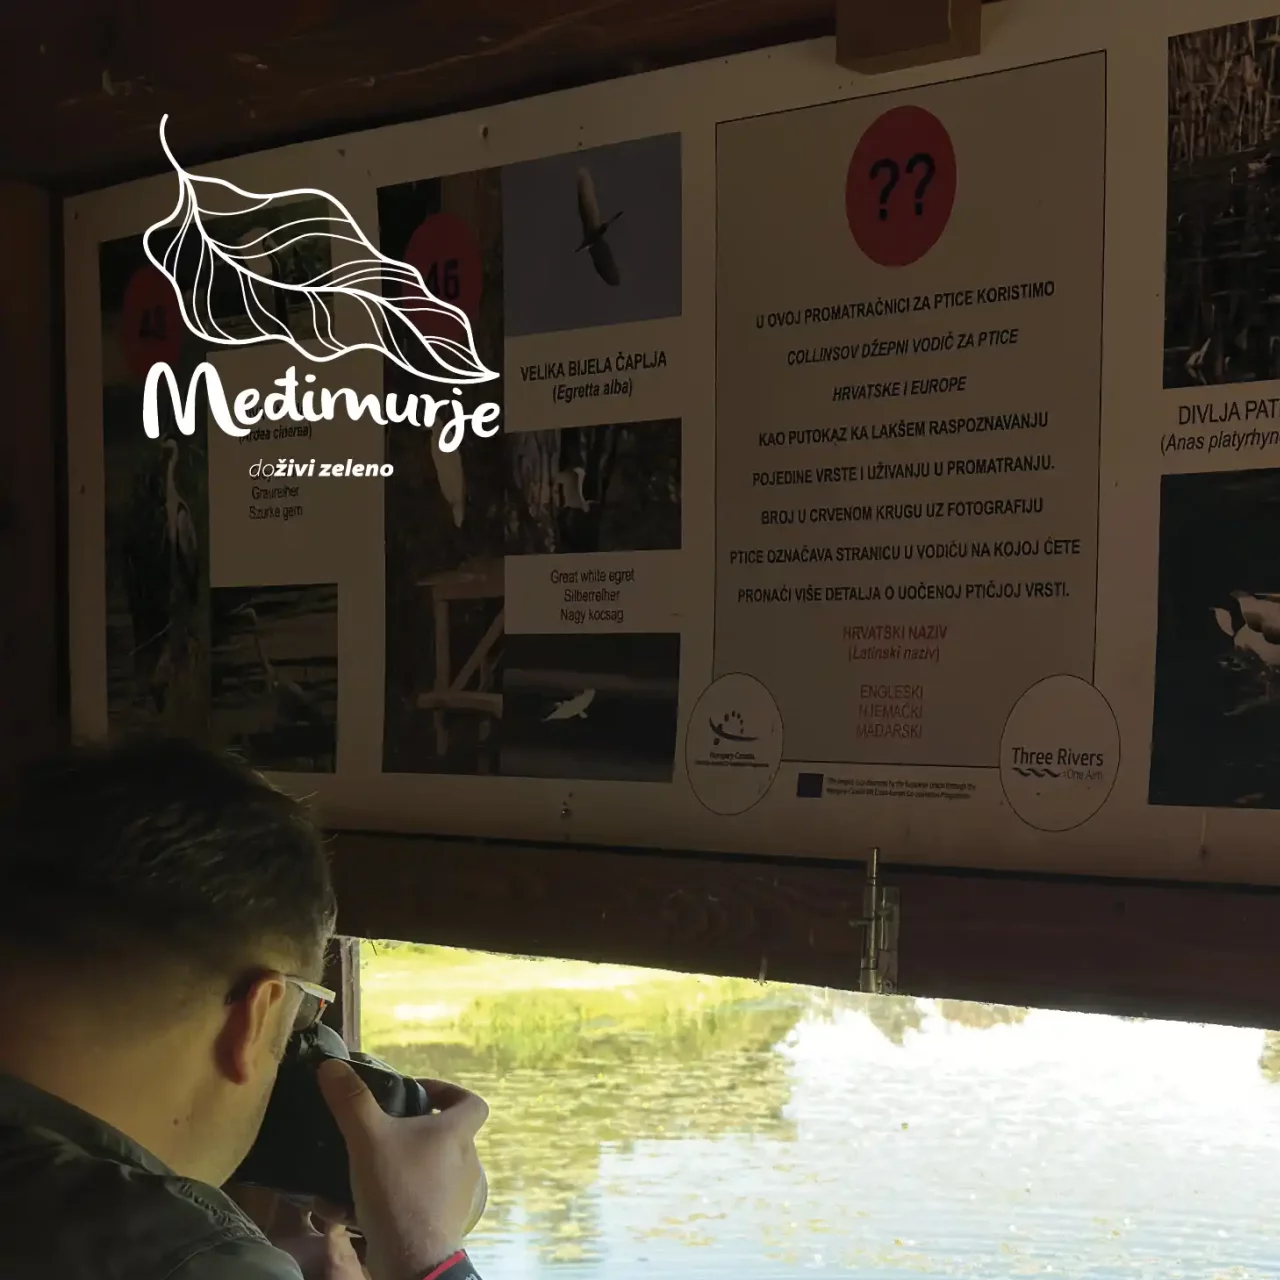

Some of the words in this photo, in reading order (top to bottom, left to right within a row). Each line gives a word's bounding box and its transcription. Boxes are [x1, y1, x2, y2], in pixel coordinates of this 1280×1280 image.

[869, 152, 936, 221] ??
[427, 258, 460, 300] 46
[756, 315, 764, 329] U
[767, 310, 801, 328] OVOJ
[804, 298, 910, 324] PROMATRAČNICI
[913, 296, 931, 311] ZA
[934, 289, 973, 309] PTICE
[976, 280, 1055, 304] KORISTIMO
[787, 344, 859, 366] COLLINSOV
[861, 337, 909, 359] DŽEPNI
[956, 333, 975, 350] ZA
[977, 328, 1019, 348] PTICE
[520, 364, 565, 382] VELIKA
[568, 359, 612, 377] BIJELA
[615, 351, 667, 371] ČAPLJA
[552, 381, 600, 403] (Egretta
[603, 378, 633, 397] alba)
[832, 382, 900, 402] HRVATSKE
[902, 381, 908, 396] I
[910, 375, 968, 395] EUROPE
[1178, 403, 1240, 425] DIVLJA
[759, 430, 785, 447] KAO
[788, 426, 847, 445] PUTOKAZ
[850, 425, 869, 441] KA
[871, 418, 926, 440] LAKŠEM
[929, 411, 1049, 436] RASPOZNAVANJU
[1160, 429, 1205, 454] (Anas
[752, 469, 812, 487] POJEDINE
[815, 466, 857, 483] VRSTE
[867, 461, 931, 481] UŽIVANJU
[933, 463, 943, 476] U
[947, 454, 1055, 476] PROMATRANJU.
[761, 510, 794, 525] BROJ
[797, 508, 806, 523] U
[809, 504, 873, 523] CRVENOM
[875, 502, 923, 520] KRUGU
[926, 502, 944, 517] UZ
[947, 497, 1043, 517] FOTOGRAFIJU
[730, 550, 764, 564] PTICE
[836, 545, 901, 562] STRANICU
[904, 545, 913, 559] U
[971, 542, 990, 557] NA
[994, 540, 1039, 557] KOJOJ
[580, 569, 606, 583] white
[609, 569, 635, 584] egret
[795, 584, 822, 601] VIŠE
[825, 586, 881, 601] DETALJA
[885, 586, 894, 600] O
[1025, 582, 1069, 598] VRSTI.
[560, 608, 586, 624] Nagy
[589, 608, 624, 623] kocsag
[843, 625, 905, 640] HRVATSKI
[909, 624, 947, 640] NAZIV
[860, 684, 924, 699] ENGLESKI
[1012, 747, 1053, 765] Three
[1057, 748, 1104, 766] Rivers
